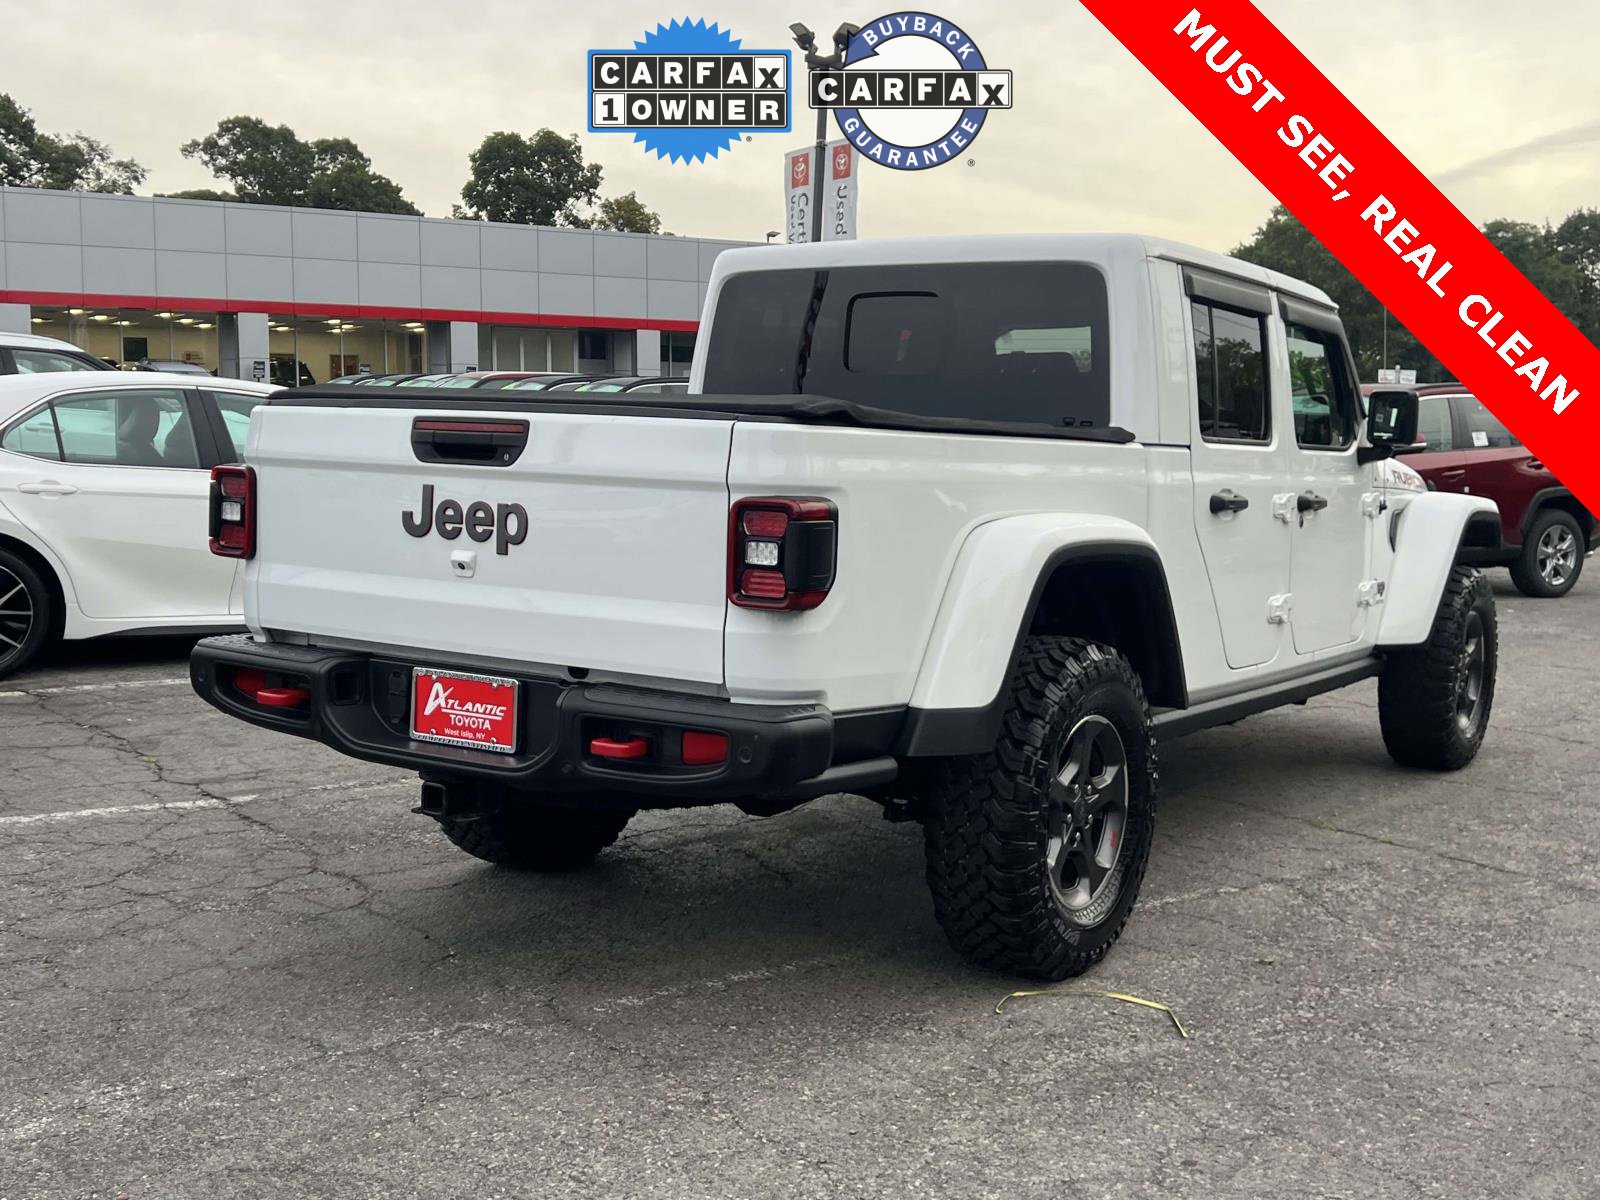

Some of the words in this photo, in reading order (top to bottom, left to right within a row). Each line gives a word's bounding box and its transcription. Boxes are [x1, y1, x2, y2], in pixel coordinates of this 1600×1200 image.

[835, 185, 847, 235] Used
[402, 484, 529, 556] Jeep
[444, 727, 459, 737] West
[476, 732, 486, 740] NY
[449, 714, 491, 731] TOYOTA
